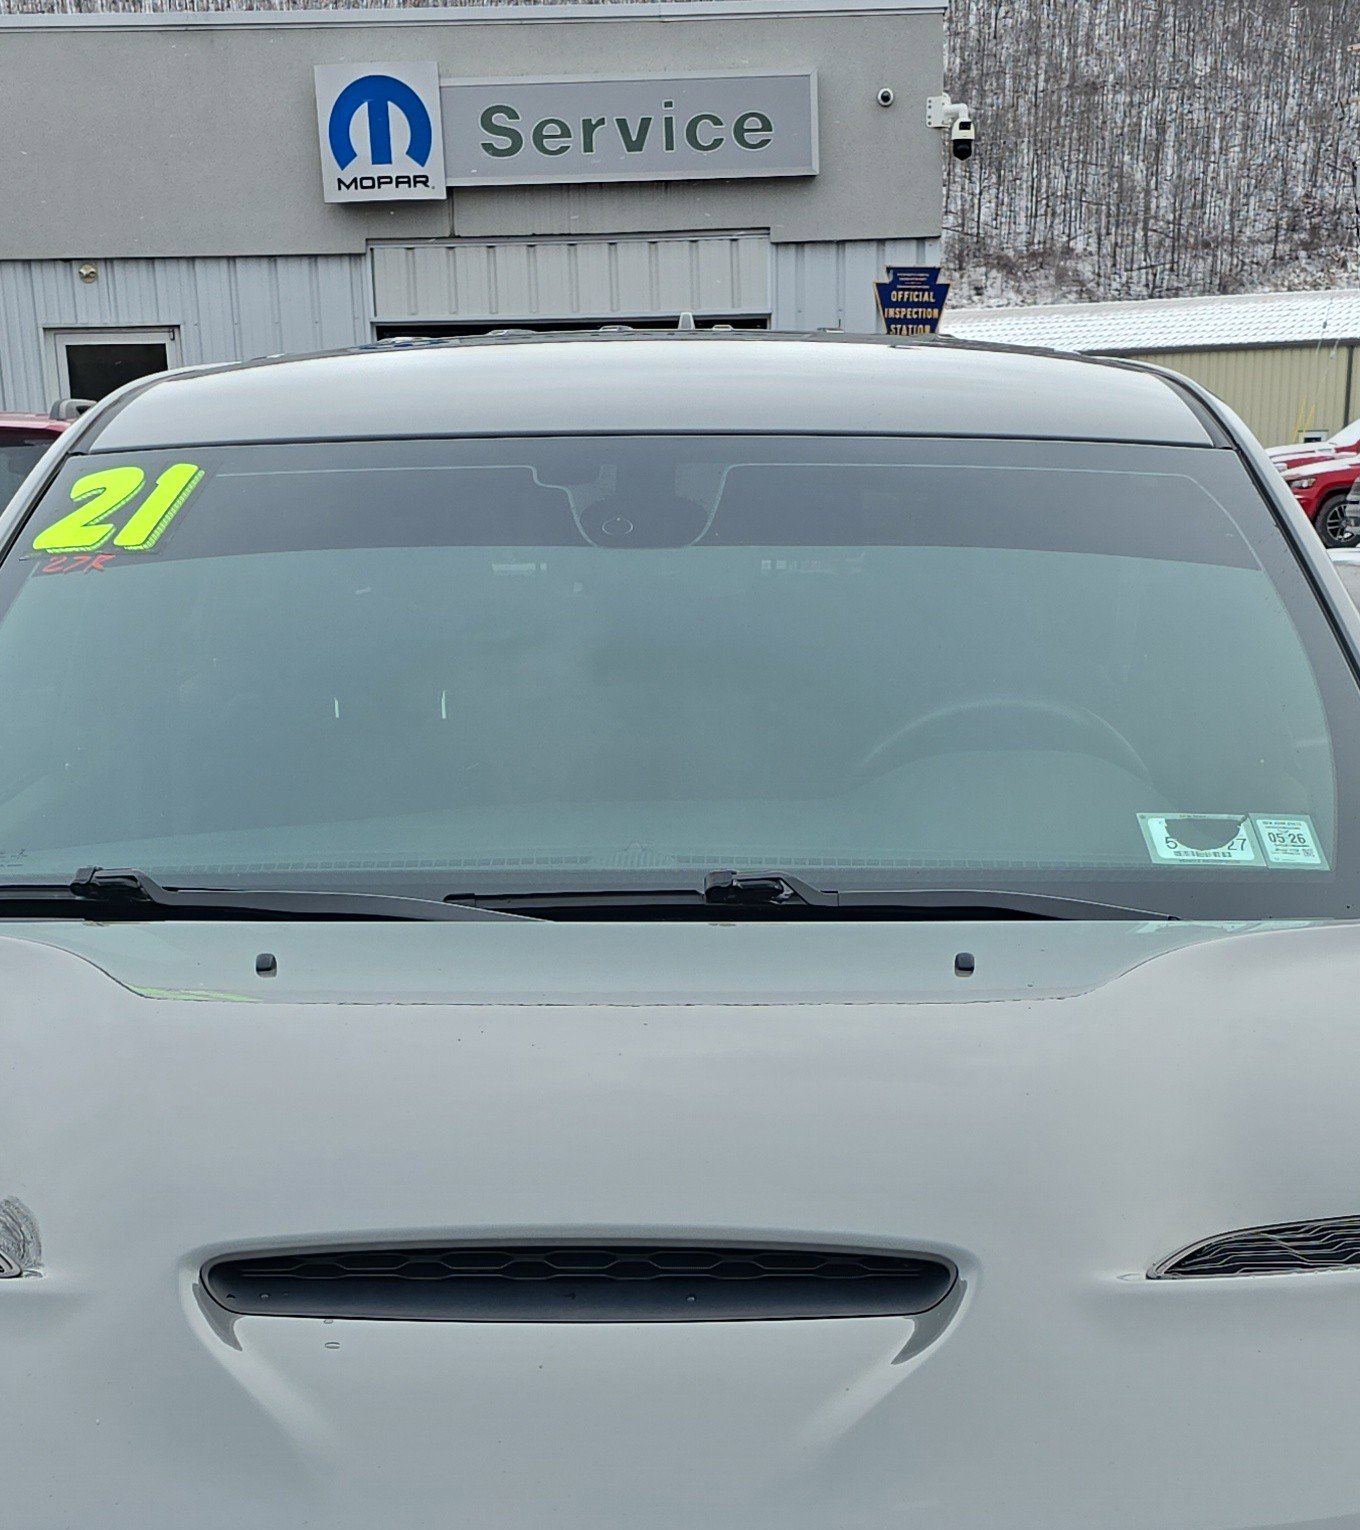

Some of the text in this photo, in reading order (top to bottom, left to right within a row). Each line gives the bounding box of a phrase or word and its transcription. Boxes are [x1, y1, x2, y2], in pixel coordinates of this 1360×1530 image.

[479, 99, 774, 159] Service
[337, 174, 430, 191] MOPAR
[890, 290, 936, 303] OFFICIAL
[884, 307, 939, 319] INSPECTION
[890, 324, 931, 336] STATION
[33, 463, 205, 554] 21
[1268, 832, 1306, 844] 05 26
